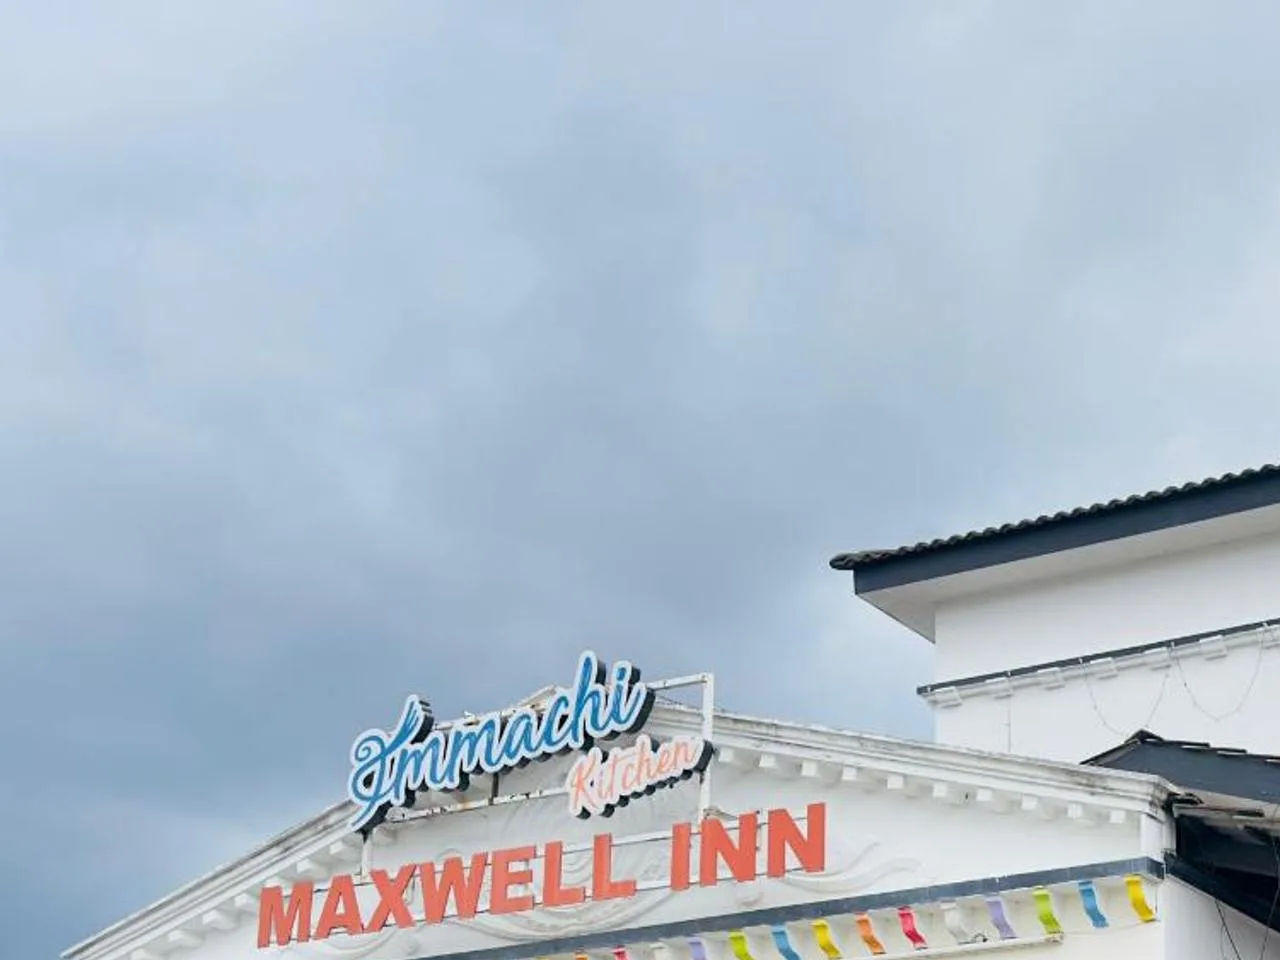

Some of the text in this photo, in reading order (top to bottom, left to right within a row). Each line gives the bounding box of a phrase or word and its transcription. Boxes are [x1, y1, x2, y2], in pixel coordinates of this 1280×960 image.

[570, 735, 699, 812] Kitchen
[257, 802, 826, 949] MAXWELL INN
